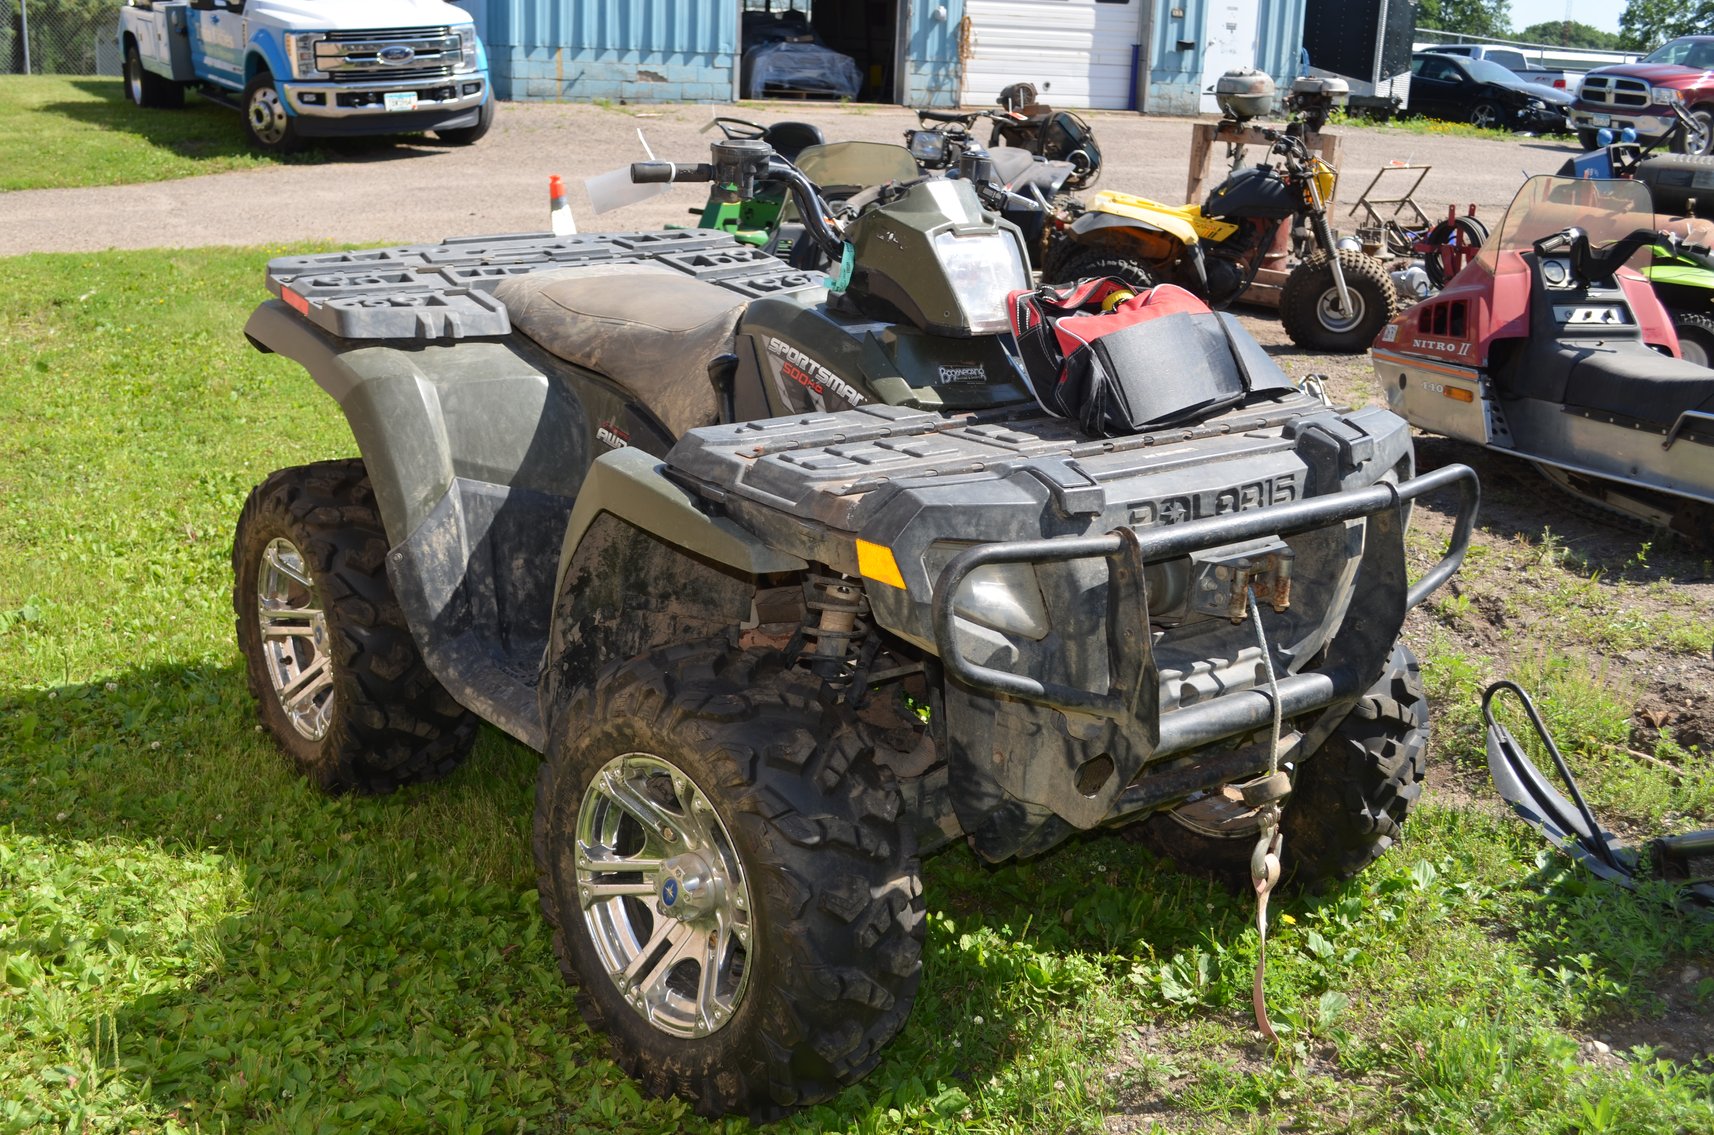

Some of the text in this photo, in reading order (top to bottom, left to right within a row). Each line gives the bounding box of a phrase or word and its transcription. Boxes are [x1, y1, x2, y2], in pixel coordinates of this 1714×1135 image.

[1413, 339, 1472, 356] NITRO II
[1126, 473, 1296, 527] POLARIS
